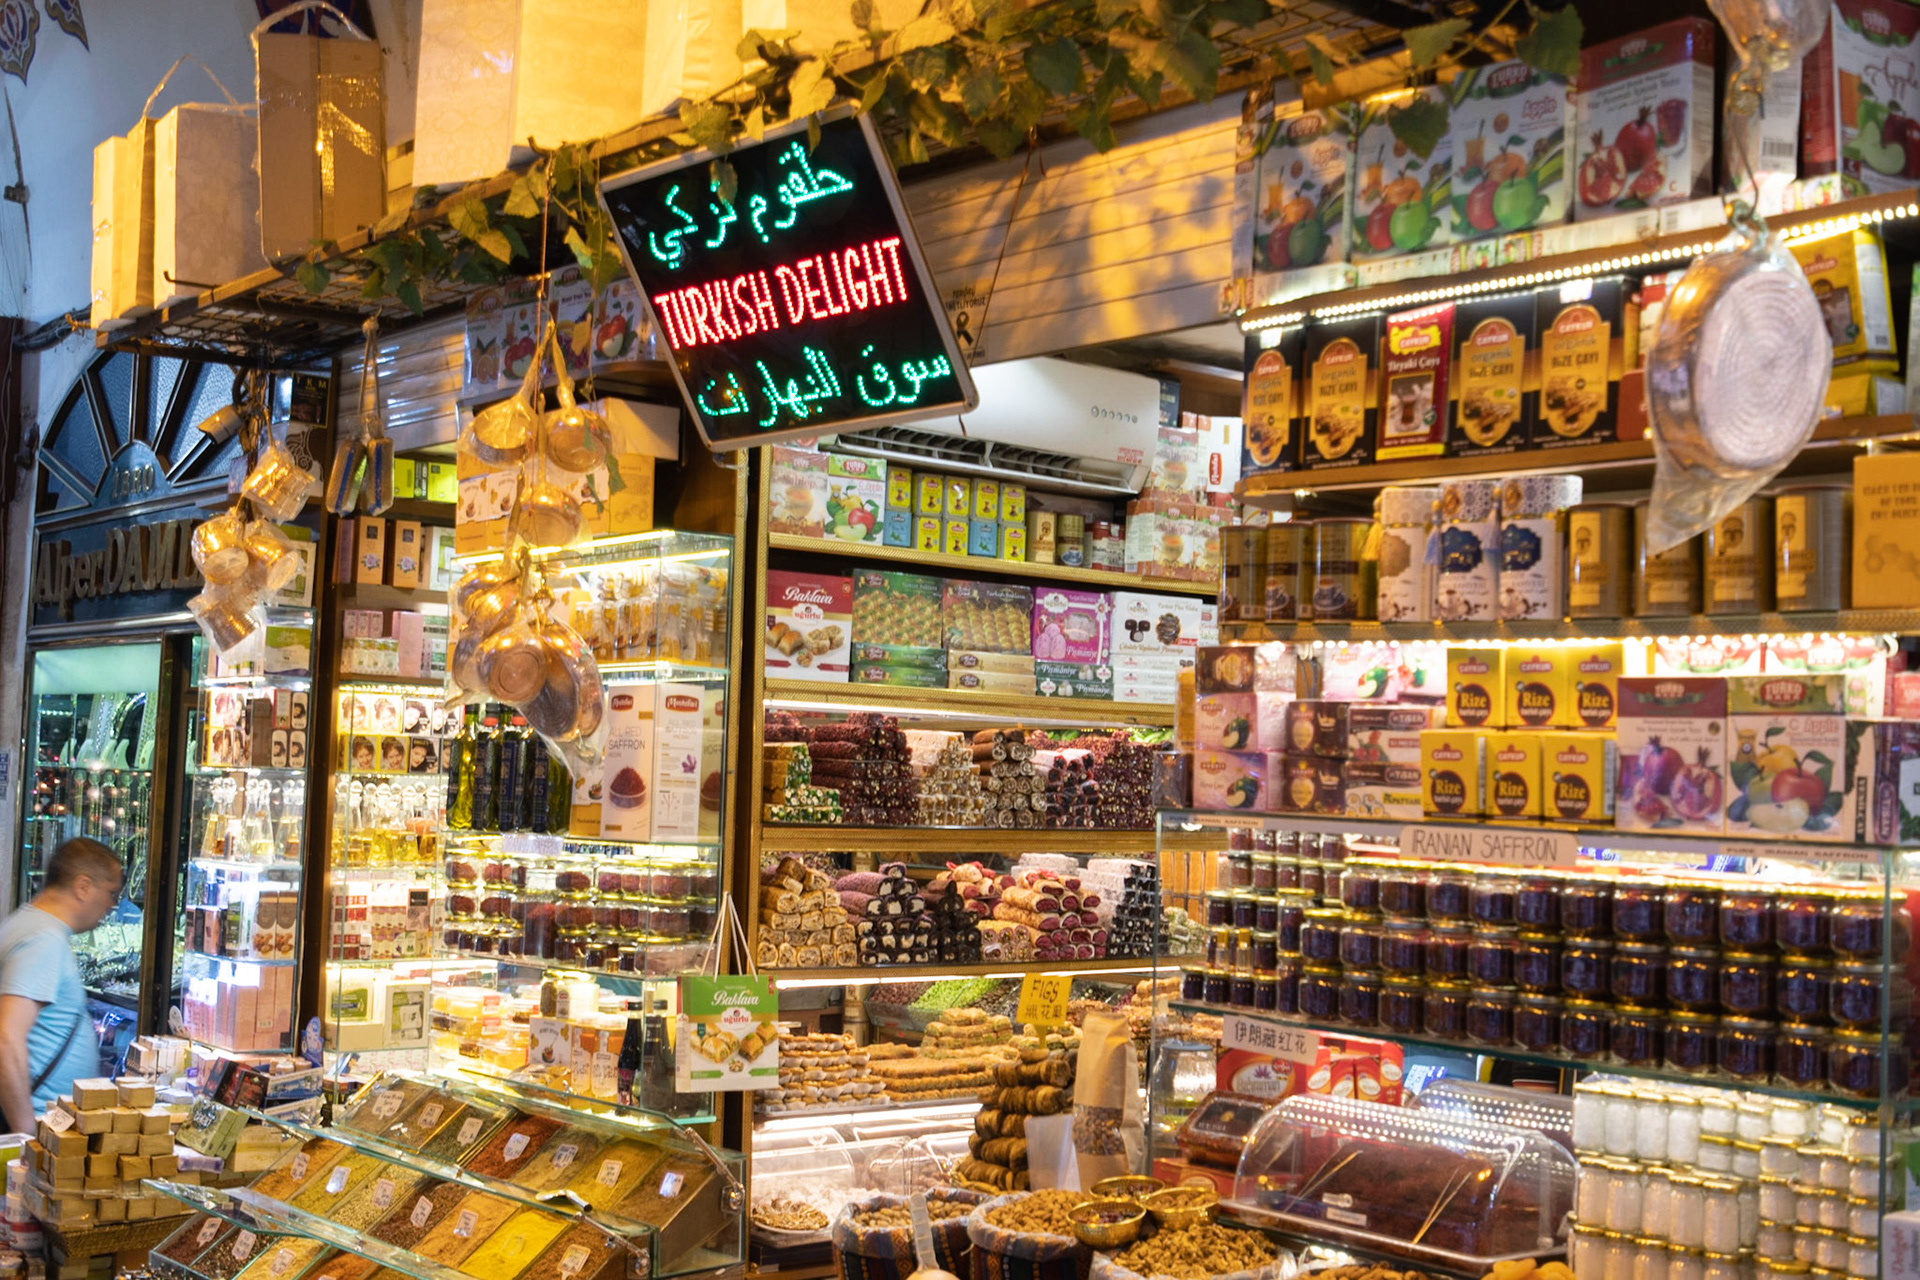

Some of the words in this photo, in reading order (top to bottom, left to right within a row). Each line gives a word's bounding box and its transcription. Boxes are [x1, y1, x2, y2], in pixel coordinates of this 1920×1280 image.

[654, 271, 779, 350] TURKISH
[775, 237, 908, 325] DELIGHT
[35, 539, 106, 619] Alper
[782, 586, 834, 605] Baklava
[1764, 682, 1803, 695] TURKO
[1460, 693, 1487, 708] Rize
[1522, 692, 1551, 708] Rize
[1582, 692, 1610, 708] Rize
[626, 726, 641, 737] RED
[1804, 719, 1839, 734] Apple
[608, 739, 645, 751] SAFFRON
[1436, 780, 1461, 795] Rize
[1500, 782, 1524, 797] Rize
[1559, 784, 1586, 799] Rize
[1481, 834, 1558, 861] SAFFRON
[711, 990, 760, 1006] Baklava
[1030, 979, 1060, 1003] FIGS
[723, 1015, 749, 1025] uğurlu
